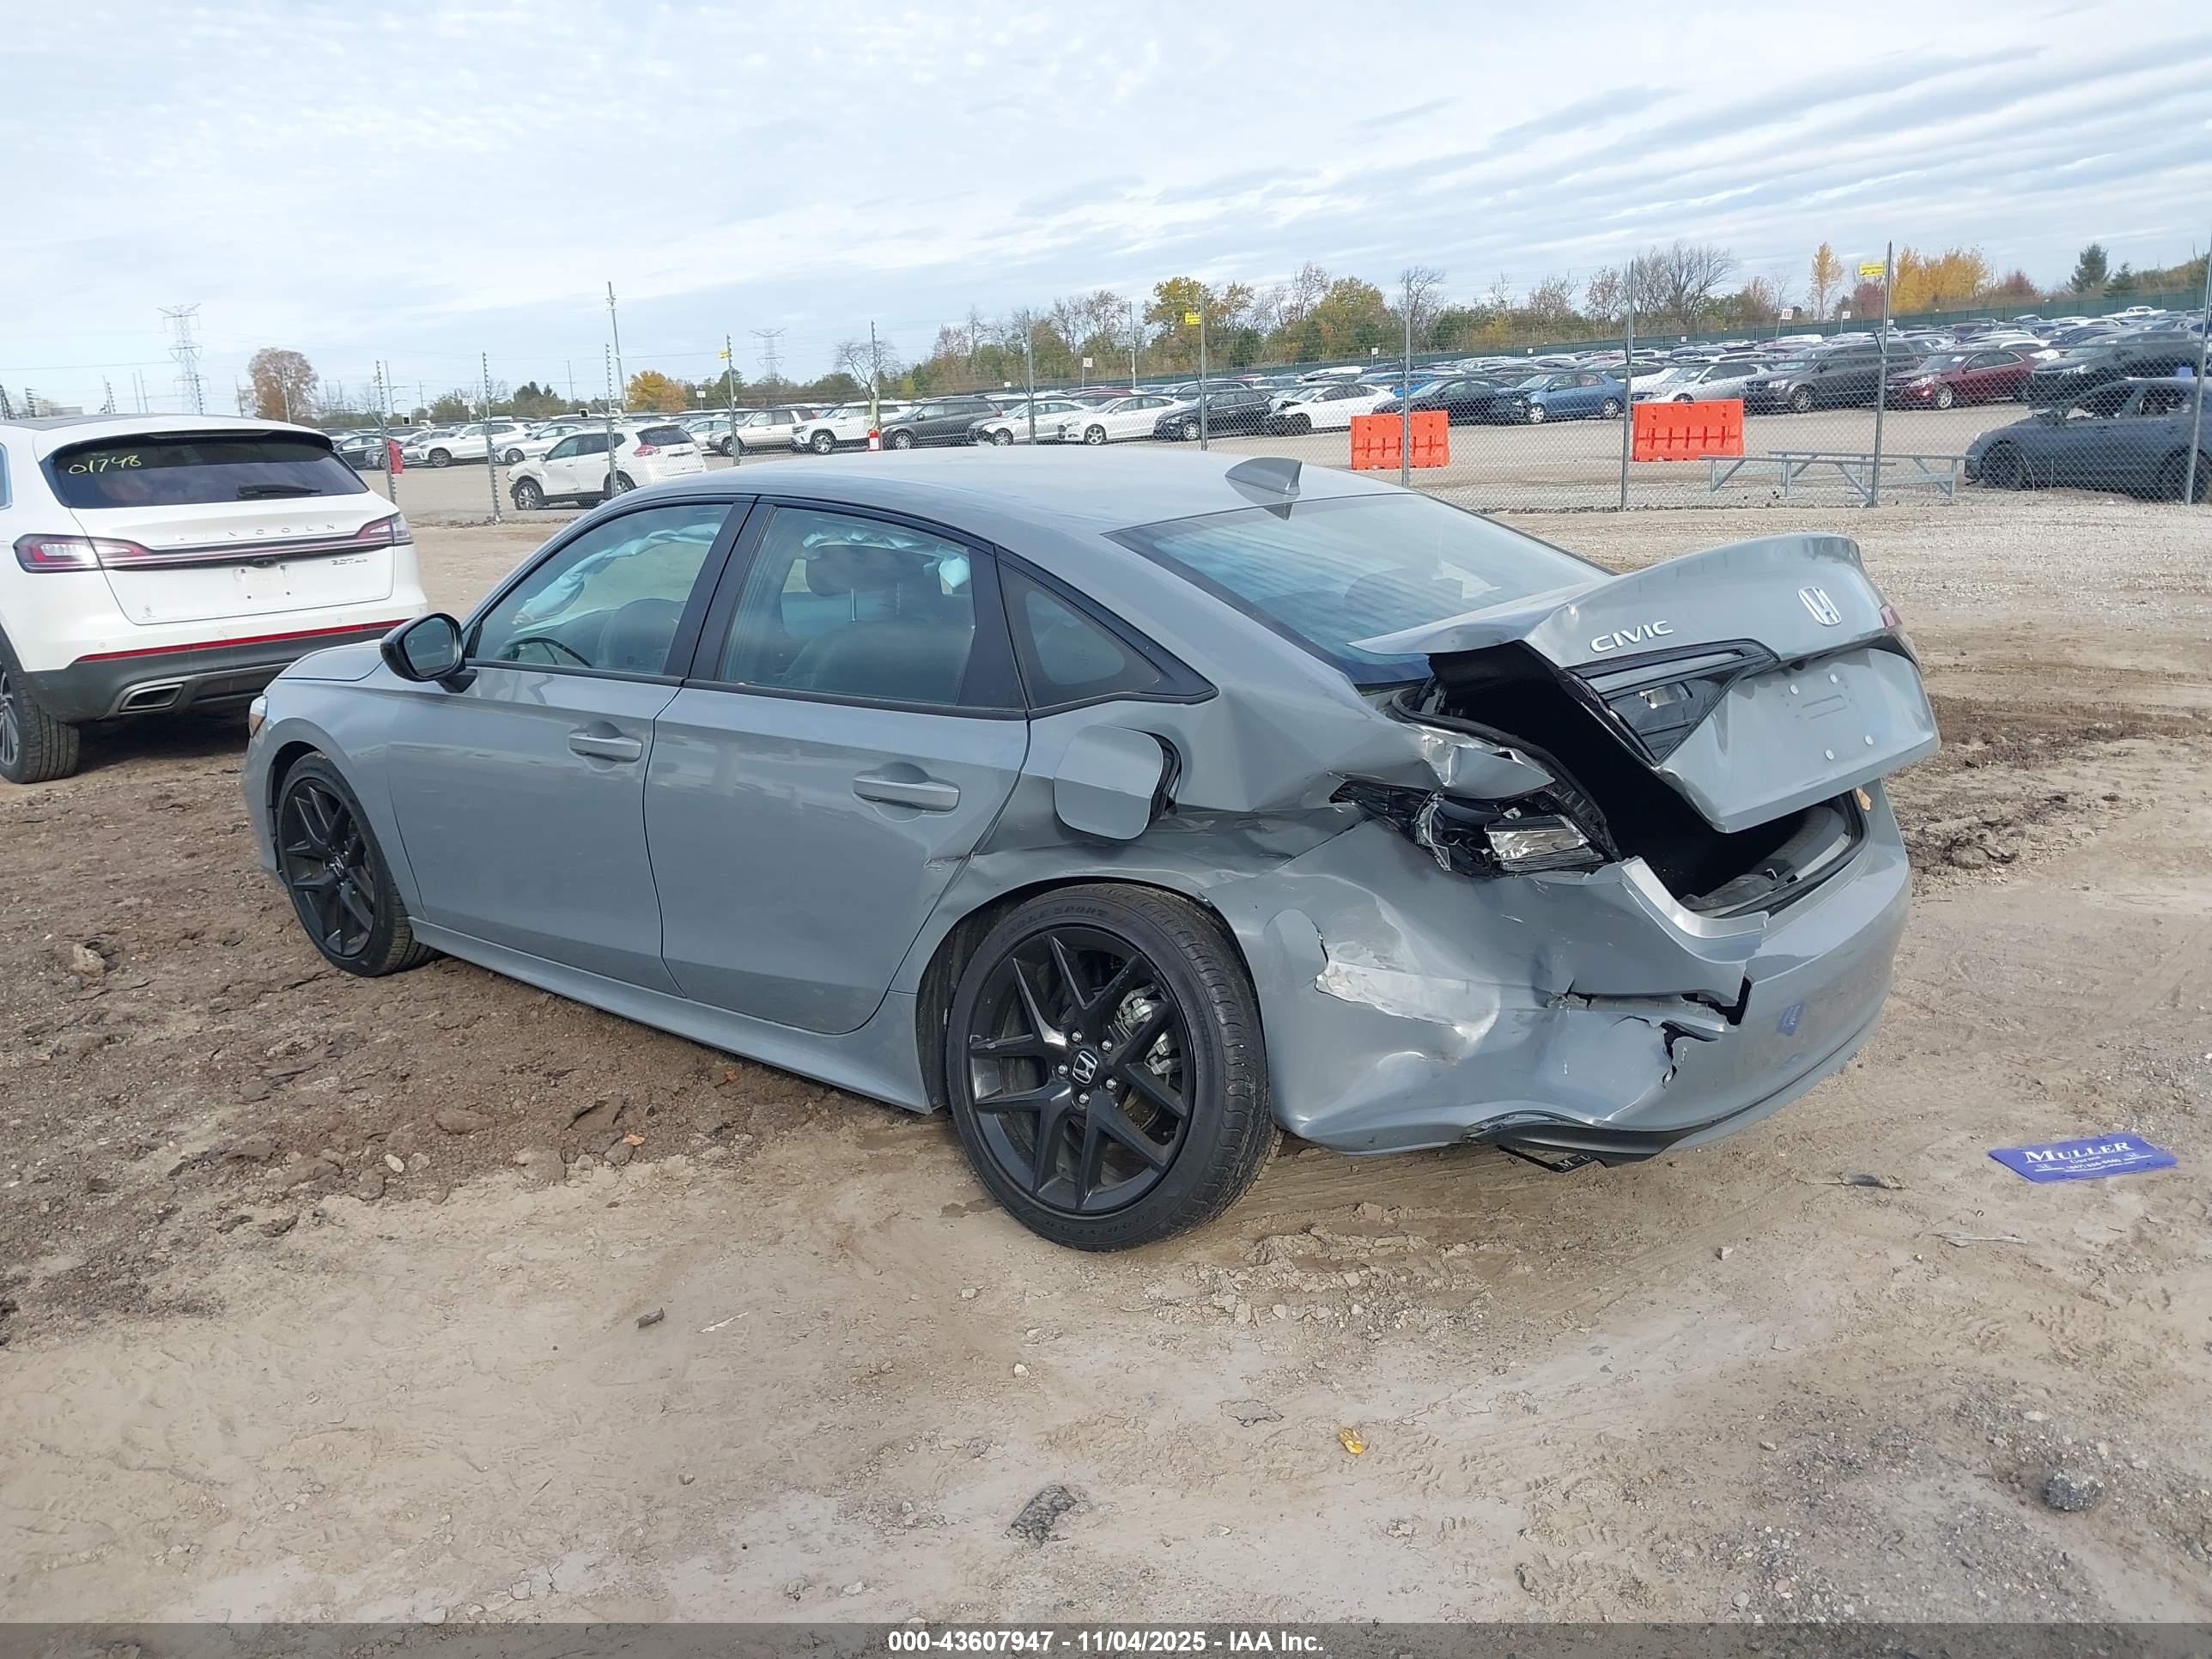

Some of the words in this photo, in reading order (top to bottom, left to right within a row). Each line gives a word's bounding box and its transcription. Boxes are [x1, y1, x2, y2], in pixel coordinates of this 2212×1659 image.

[68, 454, 143, 474] 01748
[1590, 620, 1674, 653] CIVIC
[1053, 905, 1109, 917] SPORT
[2024, 1142, 2133, 1162] MULLER
